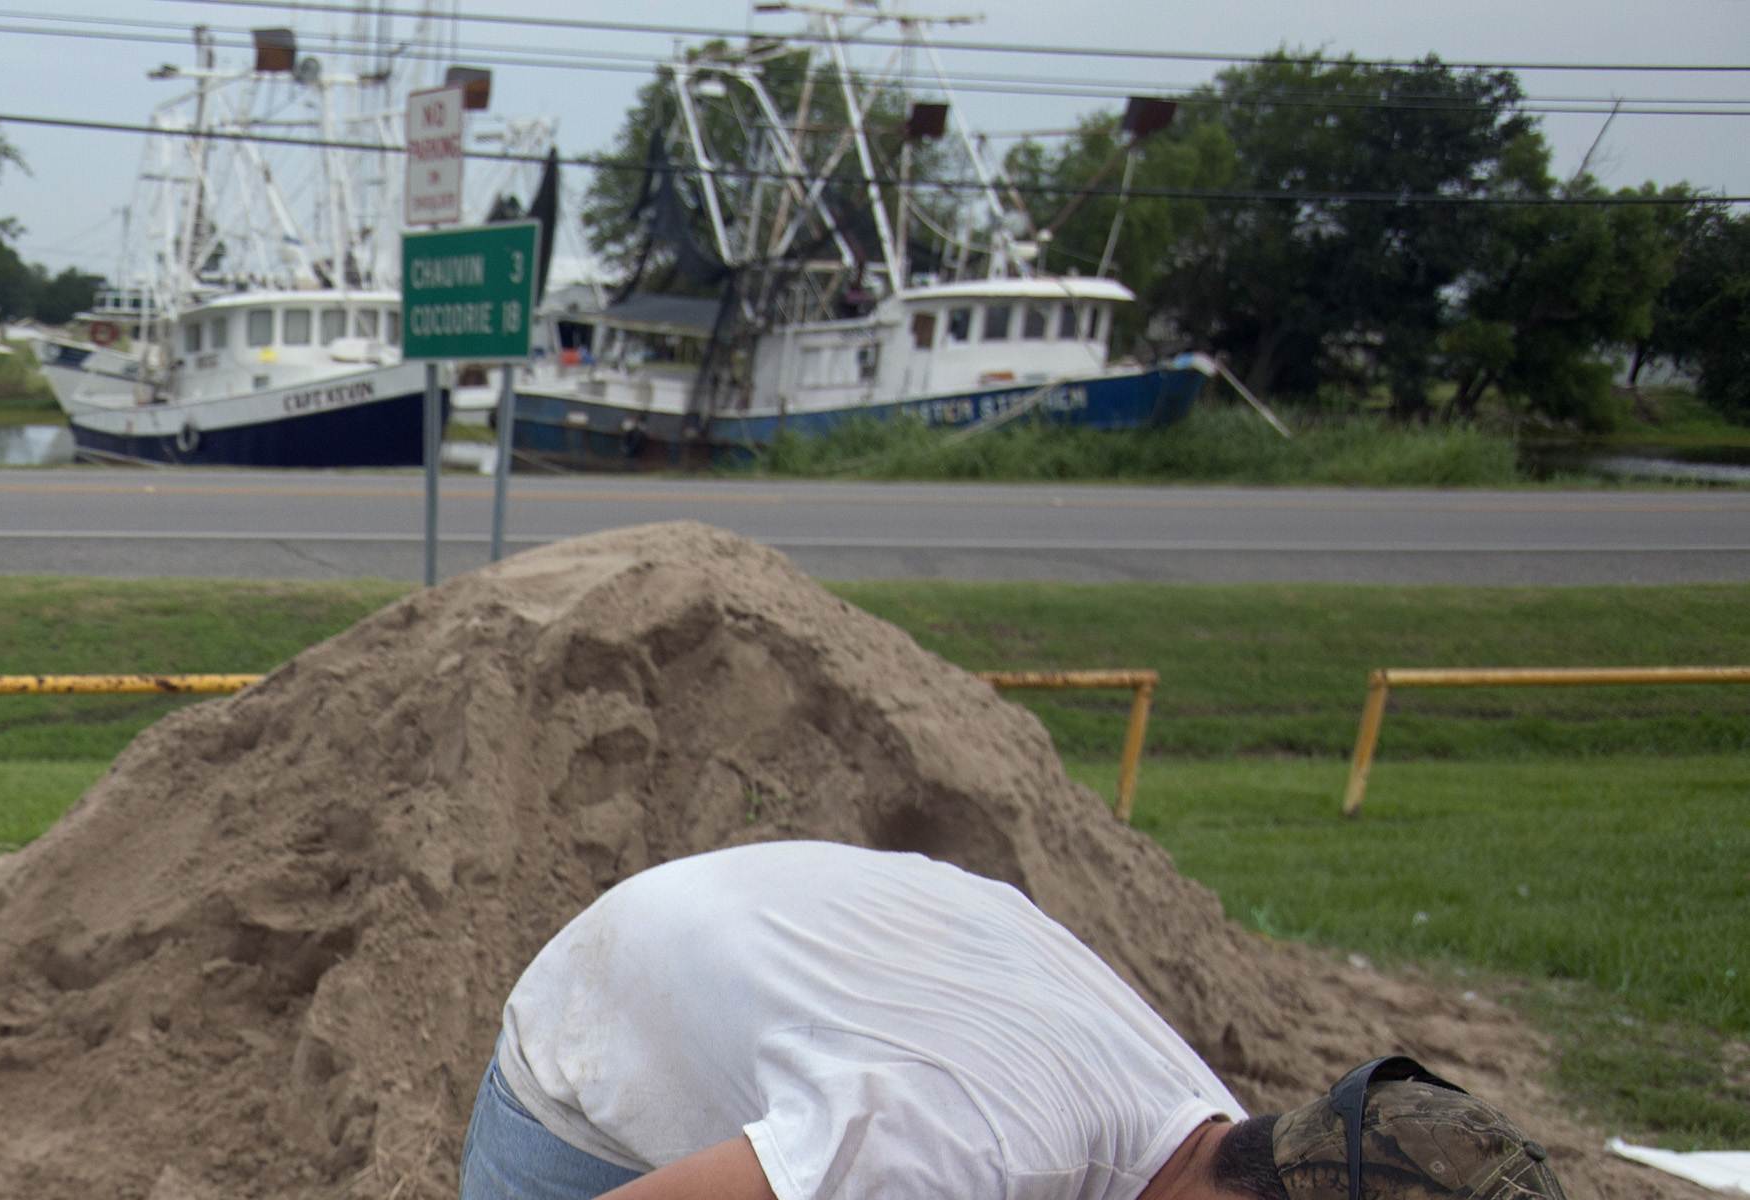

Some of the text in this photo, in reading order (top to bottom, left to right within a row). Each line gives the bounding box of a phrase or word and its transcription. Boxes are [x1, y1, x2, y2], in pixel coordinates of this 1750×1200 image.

[422, 101, 445, 128] NO
[410, 250, 524, 289] CHAUVIN 3
[410, 300, 522, 336] COCODRIE 18
